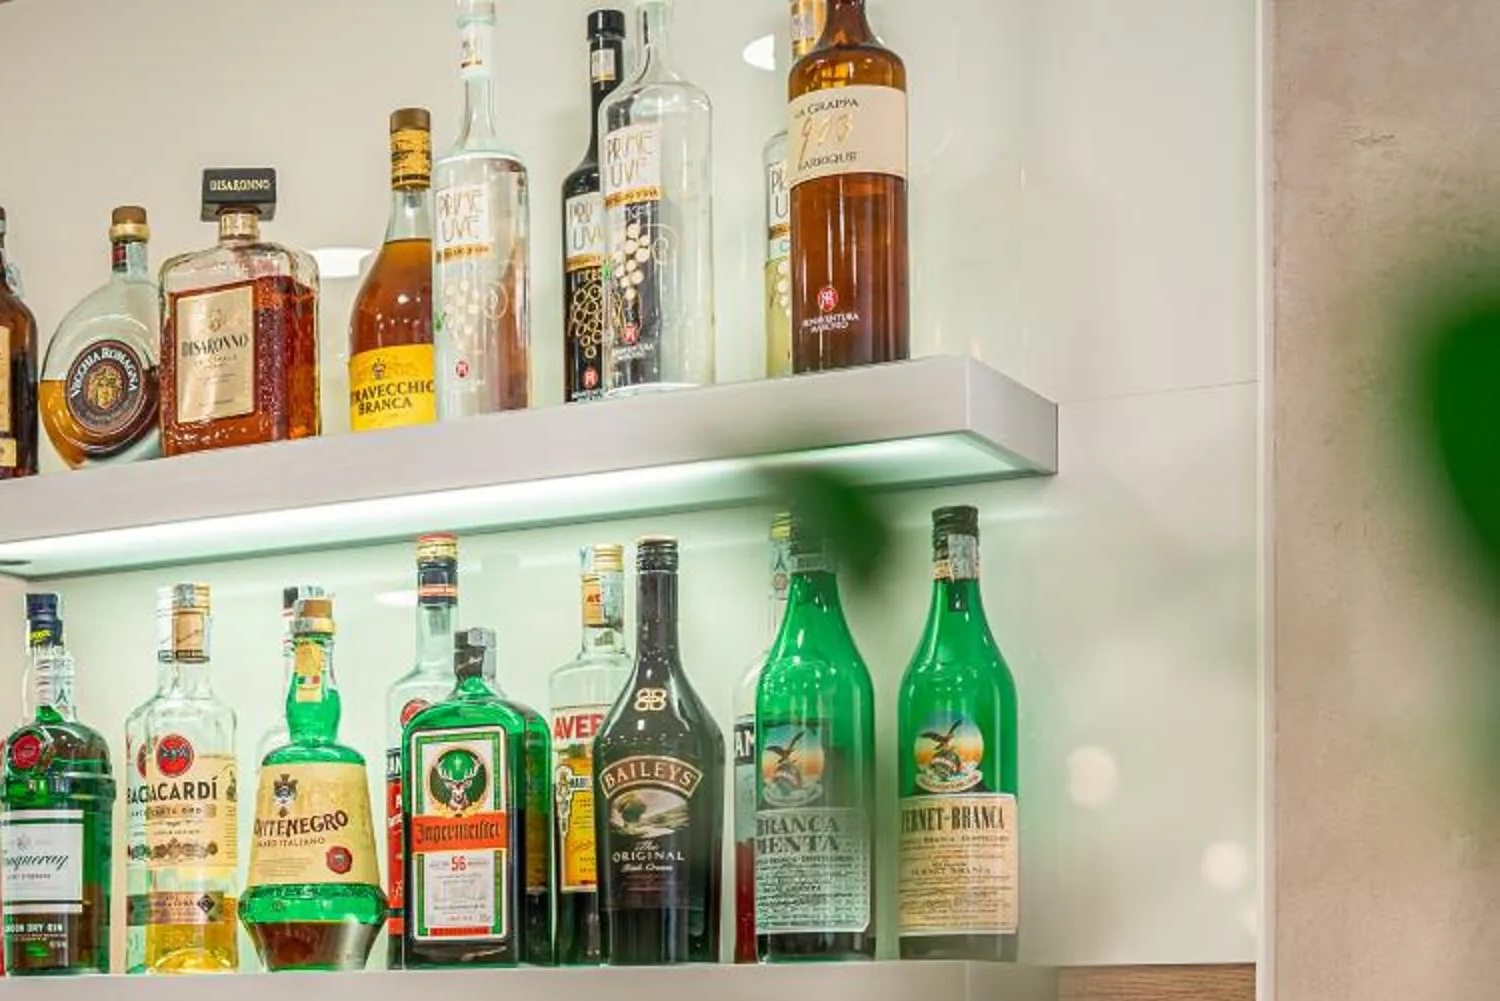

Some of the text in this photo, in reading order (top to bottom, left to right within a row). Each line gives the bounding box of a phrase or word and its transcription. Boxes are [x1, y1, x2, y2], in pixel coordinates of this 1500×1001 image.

[807, 98, 859, 114] GRAPPA
[209, 179, 270, 192] DISARONNO
[181, 333, 249, 357] DISARONNO
[358, 397, 413, 416] BRANCA
[553, 714, 605, 740] AVER
[604, 761, 694, 790] BAILEYS
[254, 809, 349, 838] ONTENEGRO
[612, 851, 685, 863] ORIGINAL
